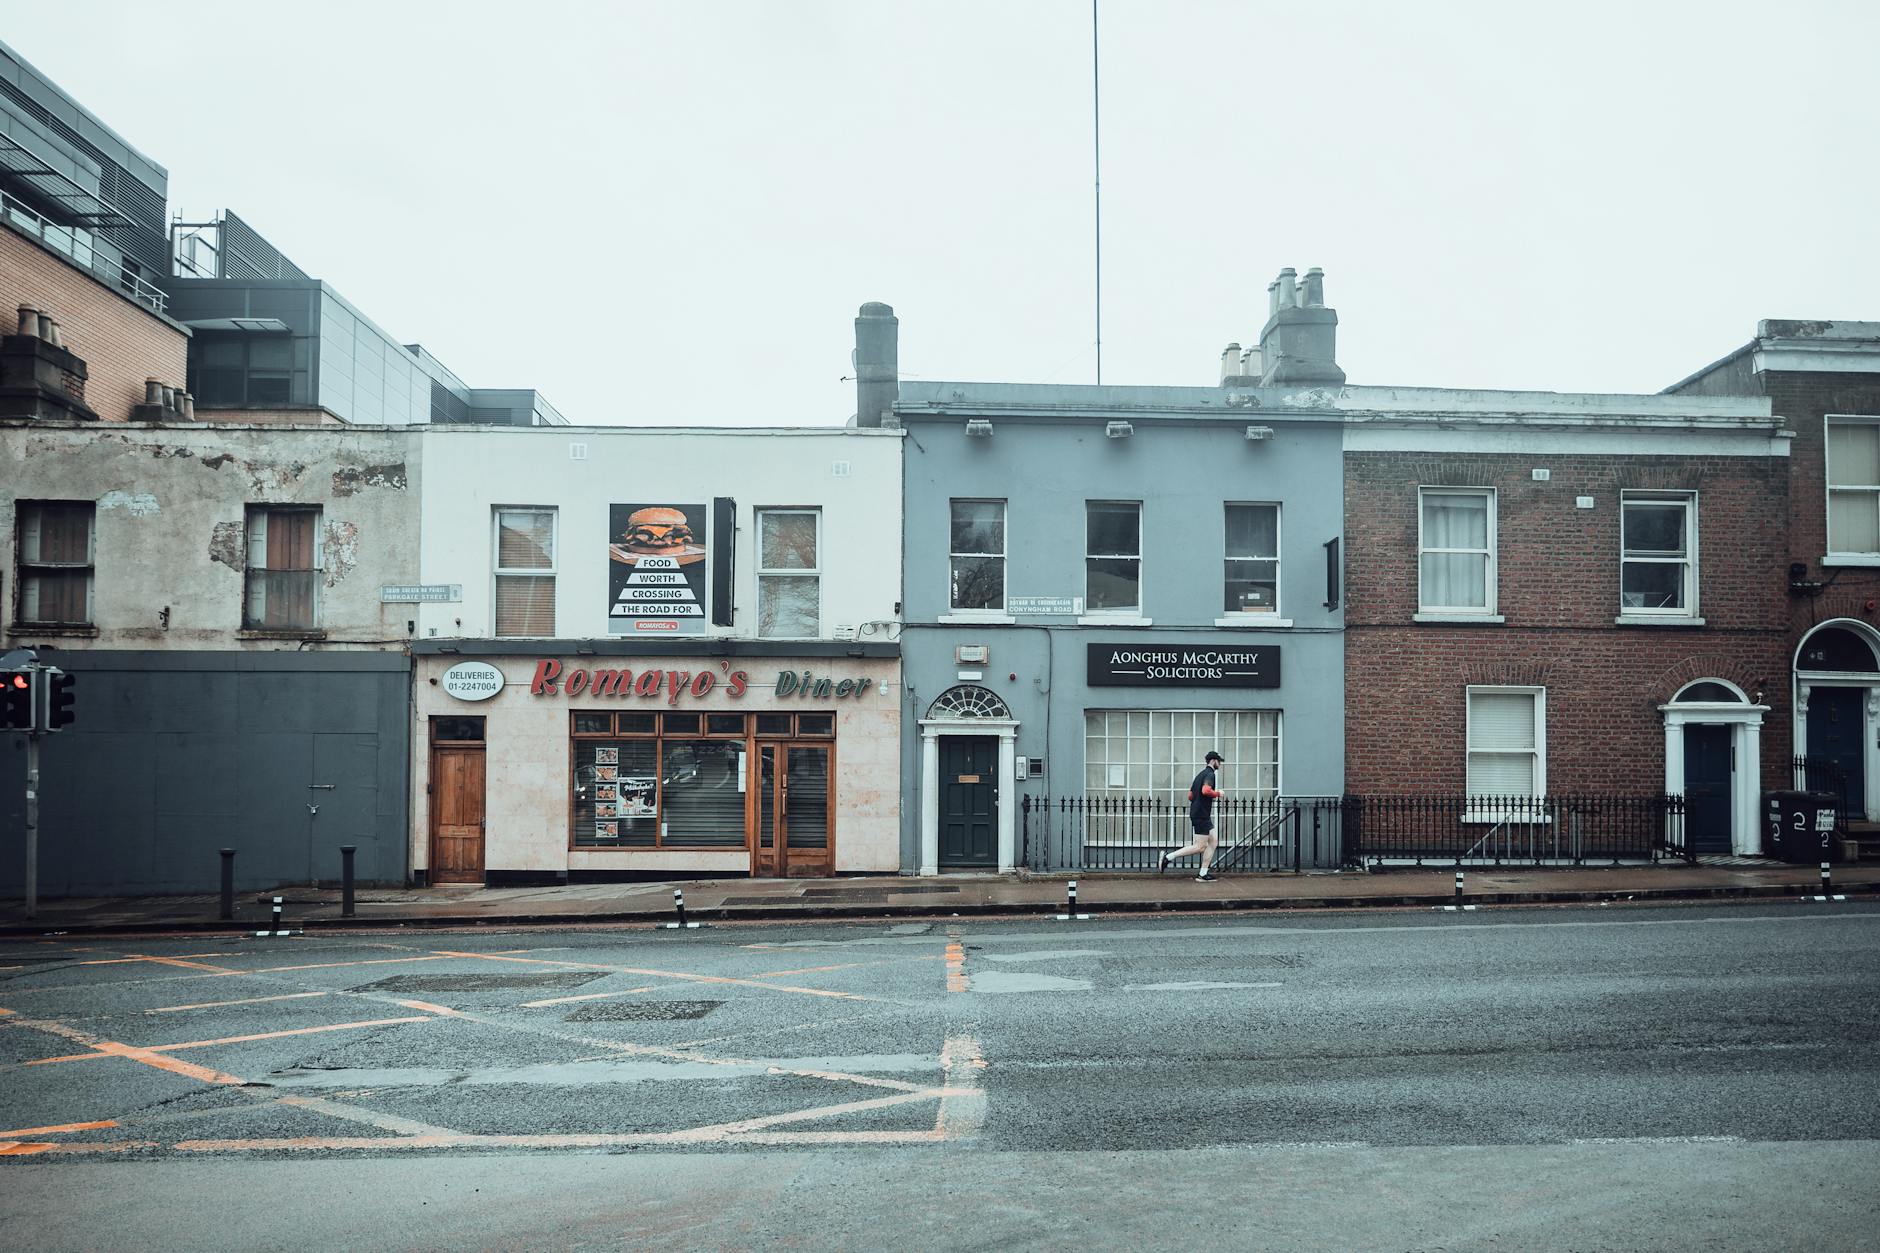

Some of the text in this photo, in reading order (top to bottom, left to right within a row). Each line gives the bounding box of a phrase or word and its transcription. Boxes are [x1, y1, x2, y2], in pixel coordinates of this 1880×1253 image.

[643, 559, 671, 567] FOOD
[639, 575, 676, 583] WORTH
[632, 590, 682, 598] CROSSING
[622, 605, 692, 613] THE ROAD FOR
[1110, 651, 1178, 664] AONGHUS
[450, 671, 495, 680] DELIVERIES
[1146, 666, 1222, 679] SOLICITORS
[448, 682, 496, 691] 01-2247004
[530, 658, 873, 705] Romayo's Diner
[1793, 812, 1806, 831] 2
[1772, 823, 1781, 842] 2
[1821, 832, 1829, 848] 2
